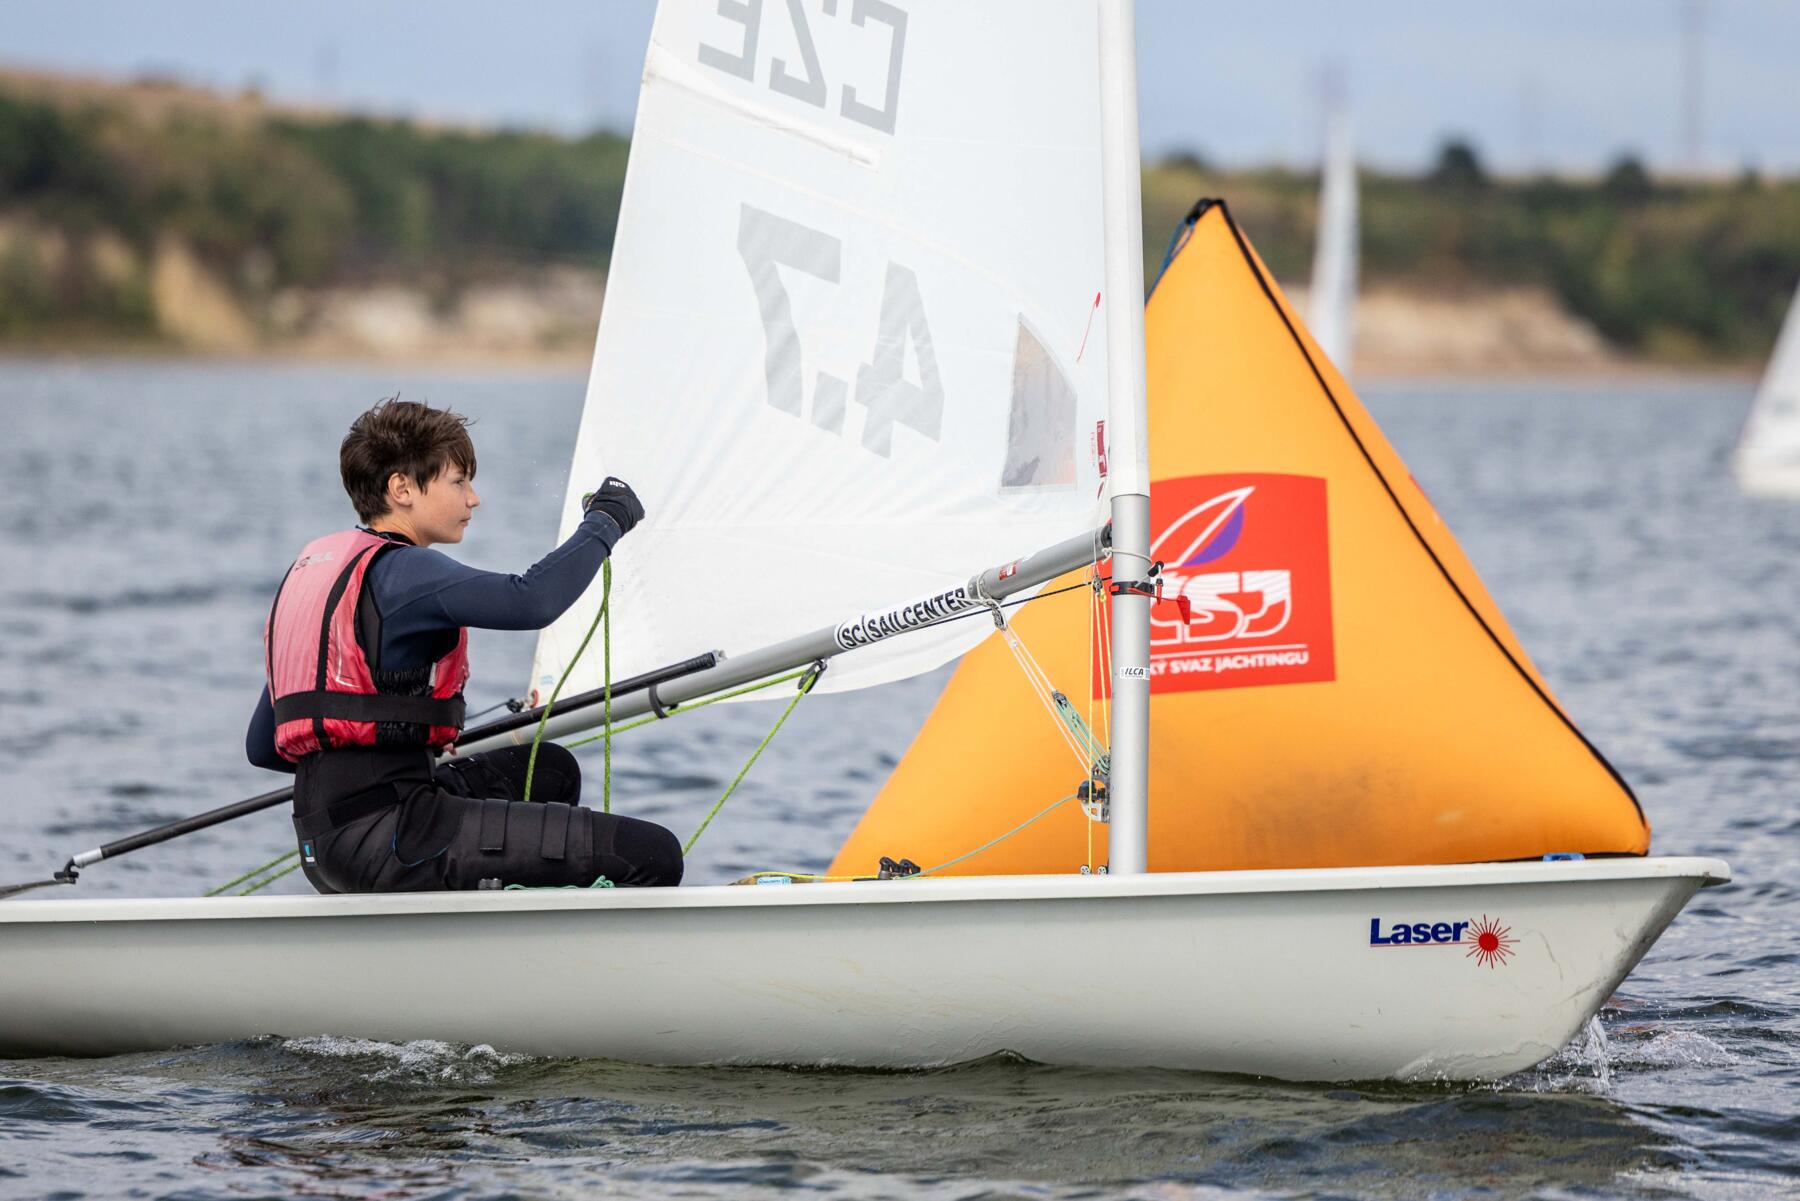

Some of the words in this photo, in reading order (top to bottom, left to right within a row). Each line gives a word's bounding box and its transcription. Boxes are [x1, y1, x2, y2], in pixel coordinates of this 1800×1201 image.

[1124, 667, 1144, 676] ILCA
[1170, 657, 1213, 674] SVAZ
[1215, 651, 1309, 673] JACHTINGU
[1370, 918, 1468, 945] Laser
